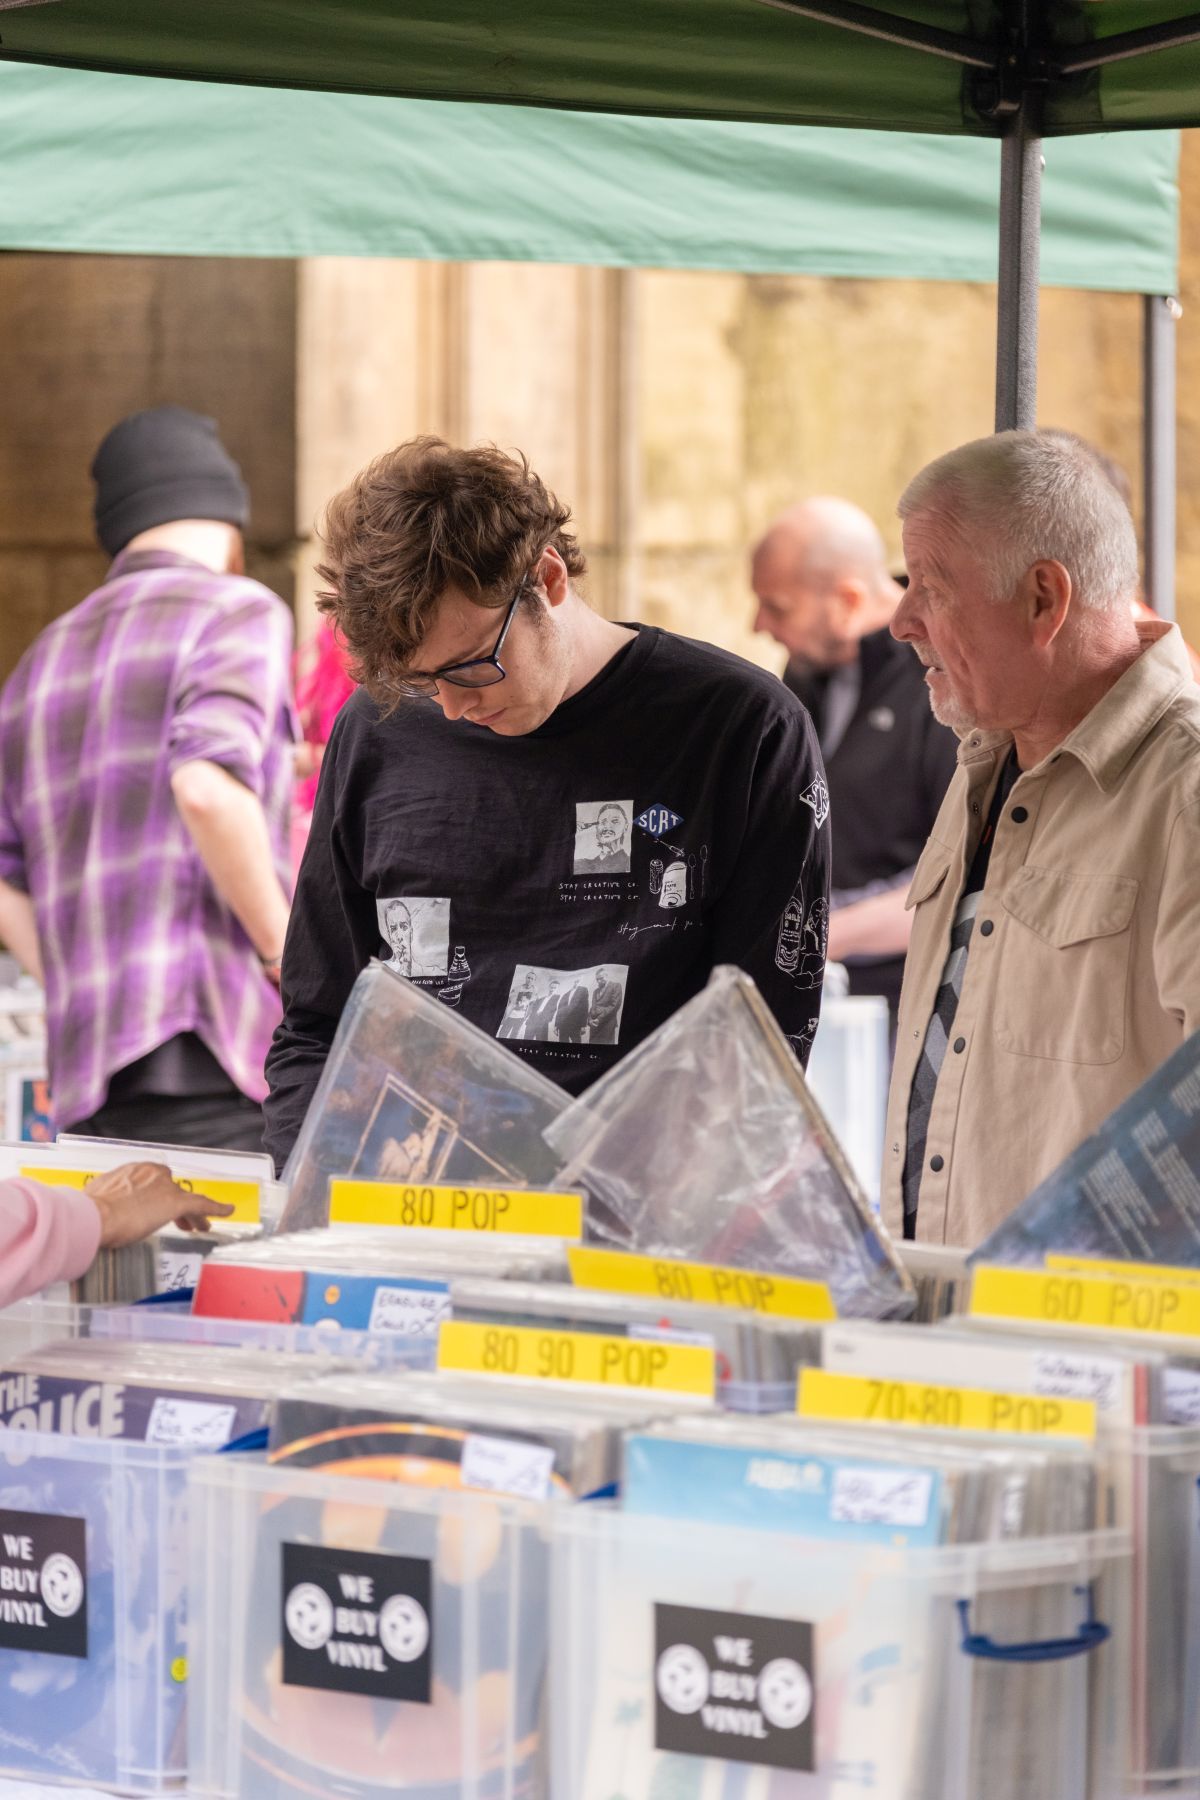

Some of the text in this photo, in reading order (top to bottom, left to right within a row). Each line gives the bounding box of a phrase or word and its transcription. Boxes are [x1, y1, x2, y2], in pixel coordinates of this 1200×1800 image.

[639, 809, 679, 834] SCRT
[558, 882, 578, 890] STAY
[583, 881, 620, 889] CREATIVE
[559, 894, 577, 902] STAY
[545, 1051, 581, 1059] CREATIVE
[401, 1188, 510, 1232] 80 POP
[653, 1262, 775, 1313] 80 POP
[1041, 1279, 1180, 1331] 60 POP
[482, 1330, 668, 1387] 80 90 POP
[0, 1383, 126, 1446] OLICE
[991, 1395, 1063, 1434] POP
[3, 1533, 33, 1561] WE
[0, 1565, 39, 1594] BUY
[338, 1573, 375, 1603] WE
[335, 1606, 377, 1638] BUY
[326, 1640, 388, 1672] VINYL
[713, 1635, 753, 1667] WE
[711, 1670, 757, 1702] BUY
[701, 1703, 769, 1739] VINYL
